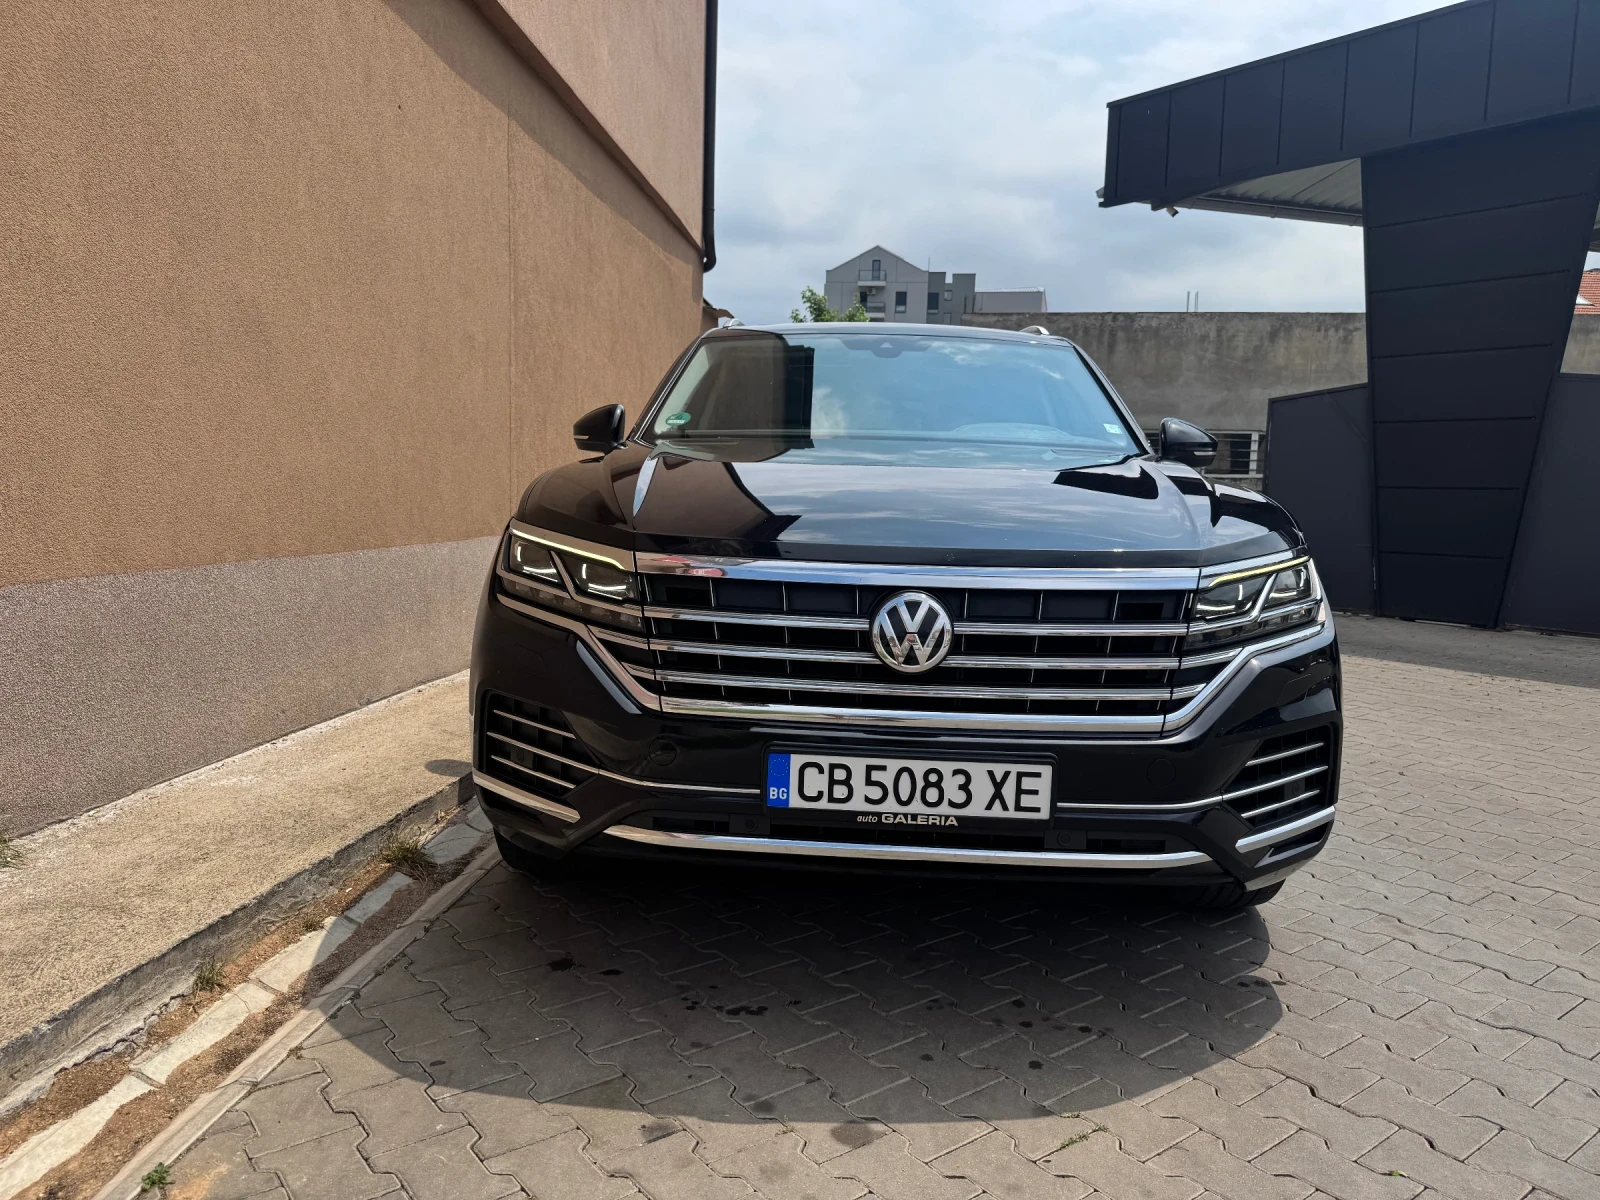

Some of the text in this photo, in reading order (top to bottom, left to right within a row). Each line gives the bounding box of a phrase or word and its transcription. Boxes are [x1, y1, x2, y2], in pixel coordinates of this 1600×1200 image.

[769, 787, 788, 800] BG
[797, 761, 1042, 813] CB 5083 XE
[856, 813, 959, 826] auto GALERIA
